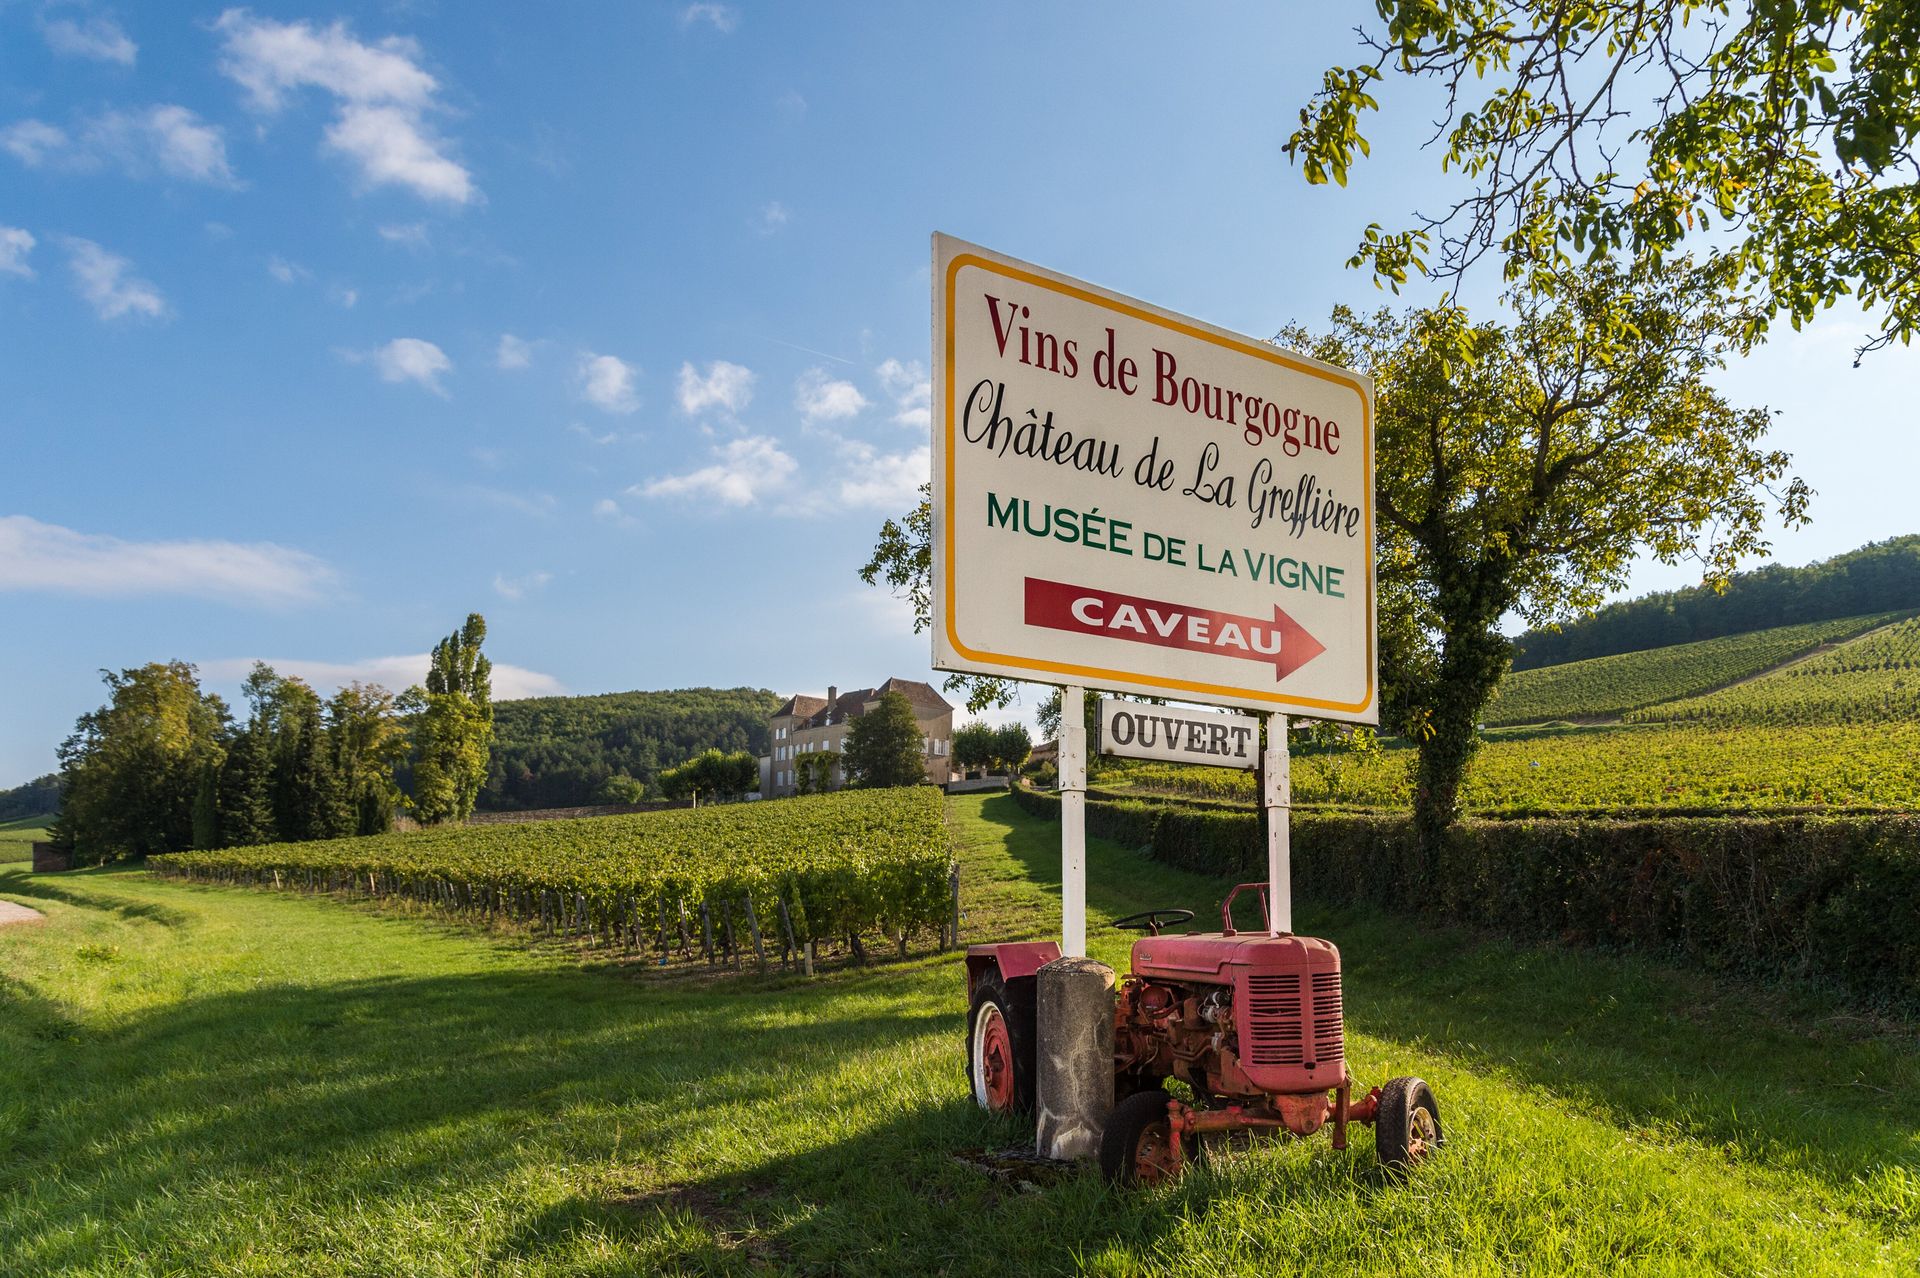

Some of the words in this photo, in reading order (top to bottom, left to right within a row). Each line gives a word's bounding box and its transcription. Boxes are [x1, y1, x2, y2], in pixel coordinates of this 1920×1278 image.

[984, 293, 1079, 379] Vins
[1093, 327, 1138, 396] de
[1152, 347, 1340, 457] Bourgogne
[962, 378, 1124, 479] Château
[1134, 436, 1175, 492] de
[1182, 441, 1237, 509] La
[1247, 457, 1361, 539] Greffière
[987, 492, 1133, 556] MUSÉE
[1143, 532, 1187, 567] DE
[1198, 543, 1238, 577] LA
[1243, 548, 1345, 599] VIGNE
[1070, 597, 1282, 655] CAVEAU
[1111, 711, 1252, 758] OUVERT
